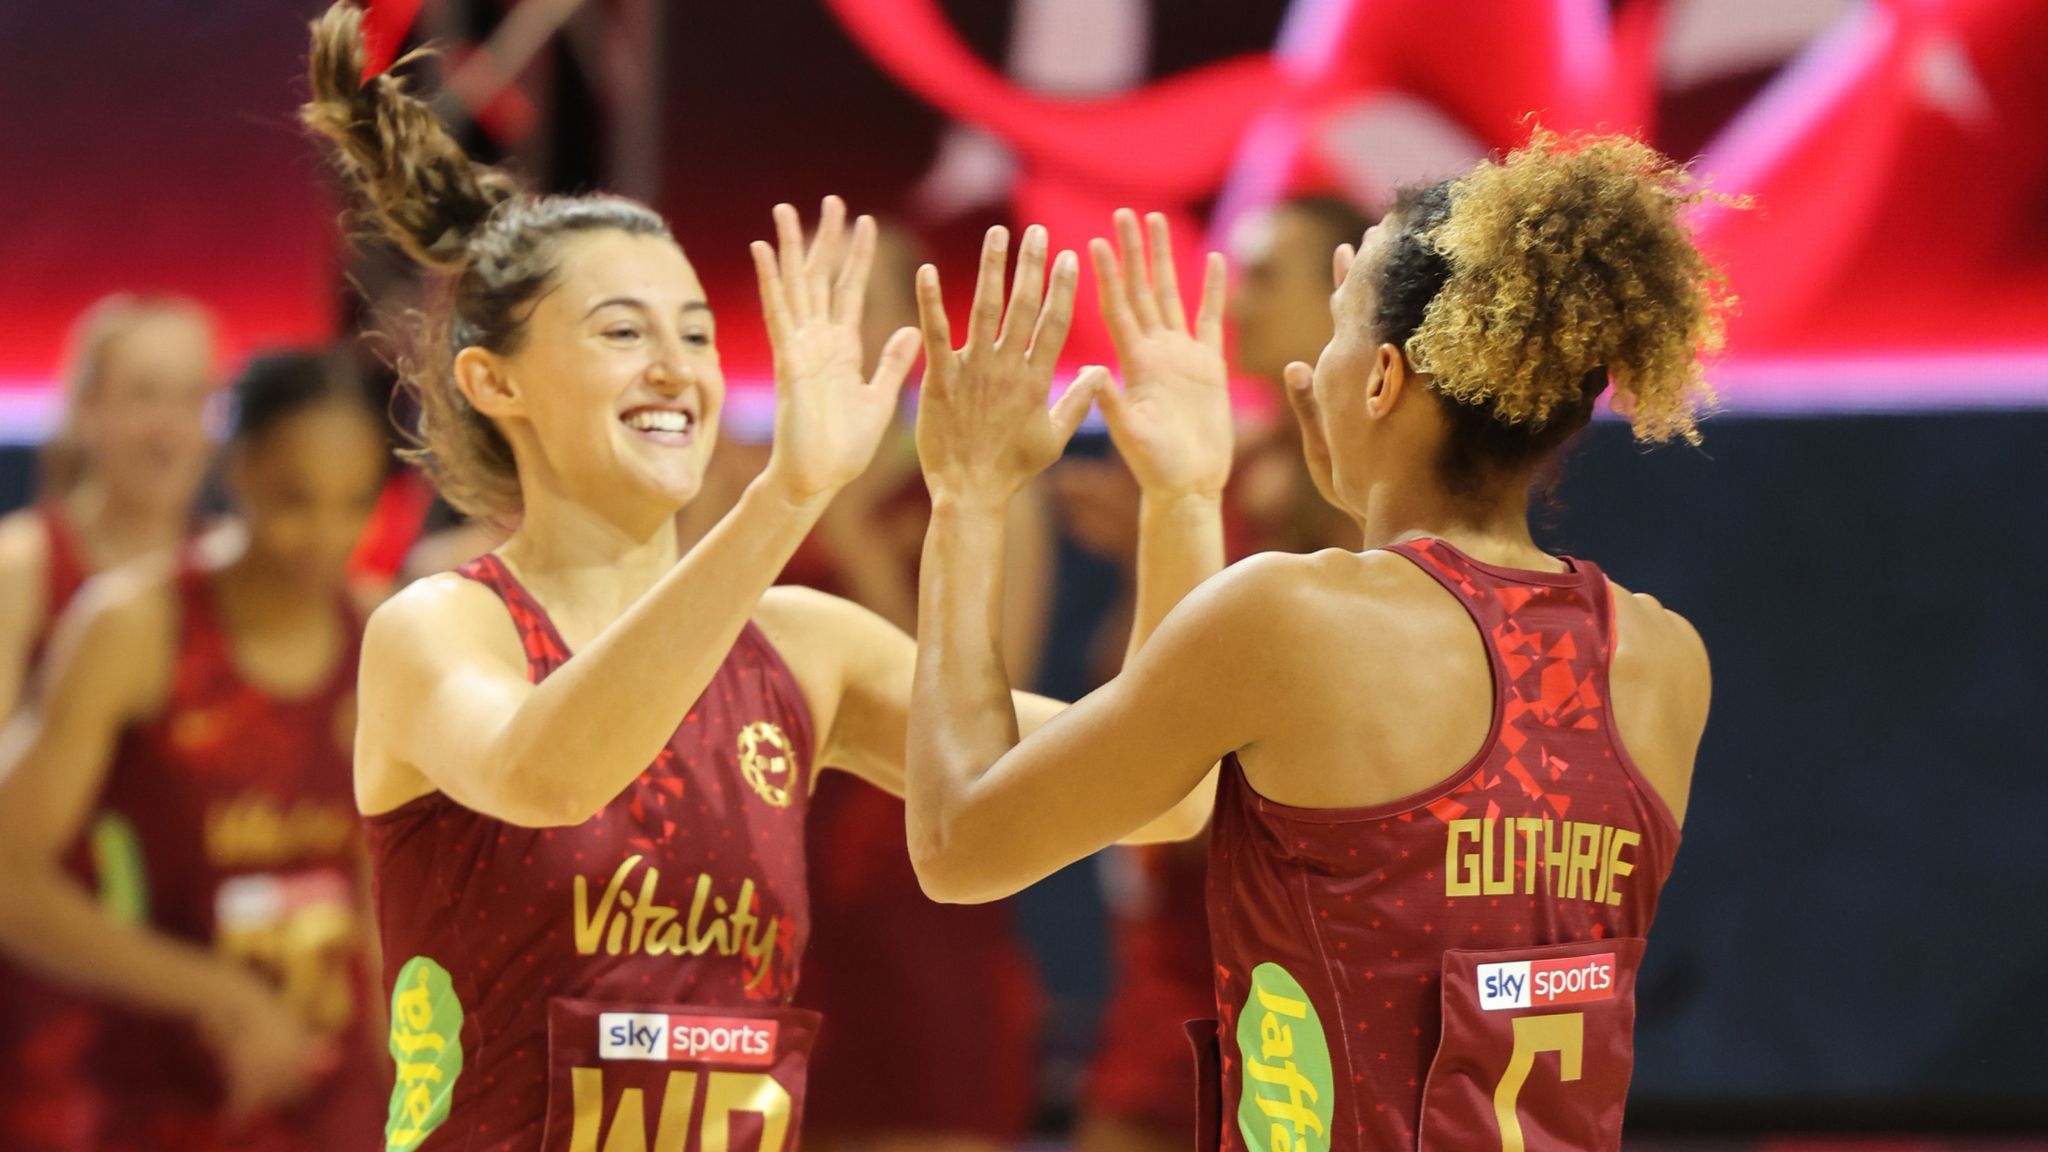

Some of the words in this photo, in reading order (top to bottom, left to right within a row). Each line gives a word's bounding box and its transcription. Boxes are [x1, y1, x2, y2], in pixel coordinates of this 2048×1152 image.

[1446, 817, 1641, 906] GUTHRIE
[573, 854, 777, 990] Vitality
[1485, 968, 1525, 1003] sky
[1535, 962, 1611, 1001] sports
[610, 1020, 662, 1053] sky
[673, 1024, 770, 1056] sports
